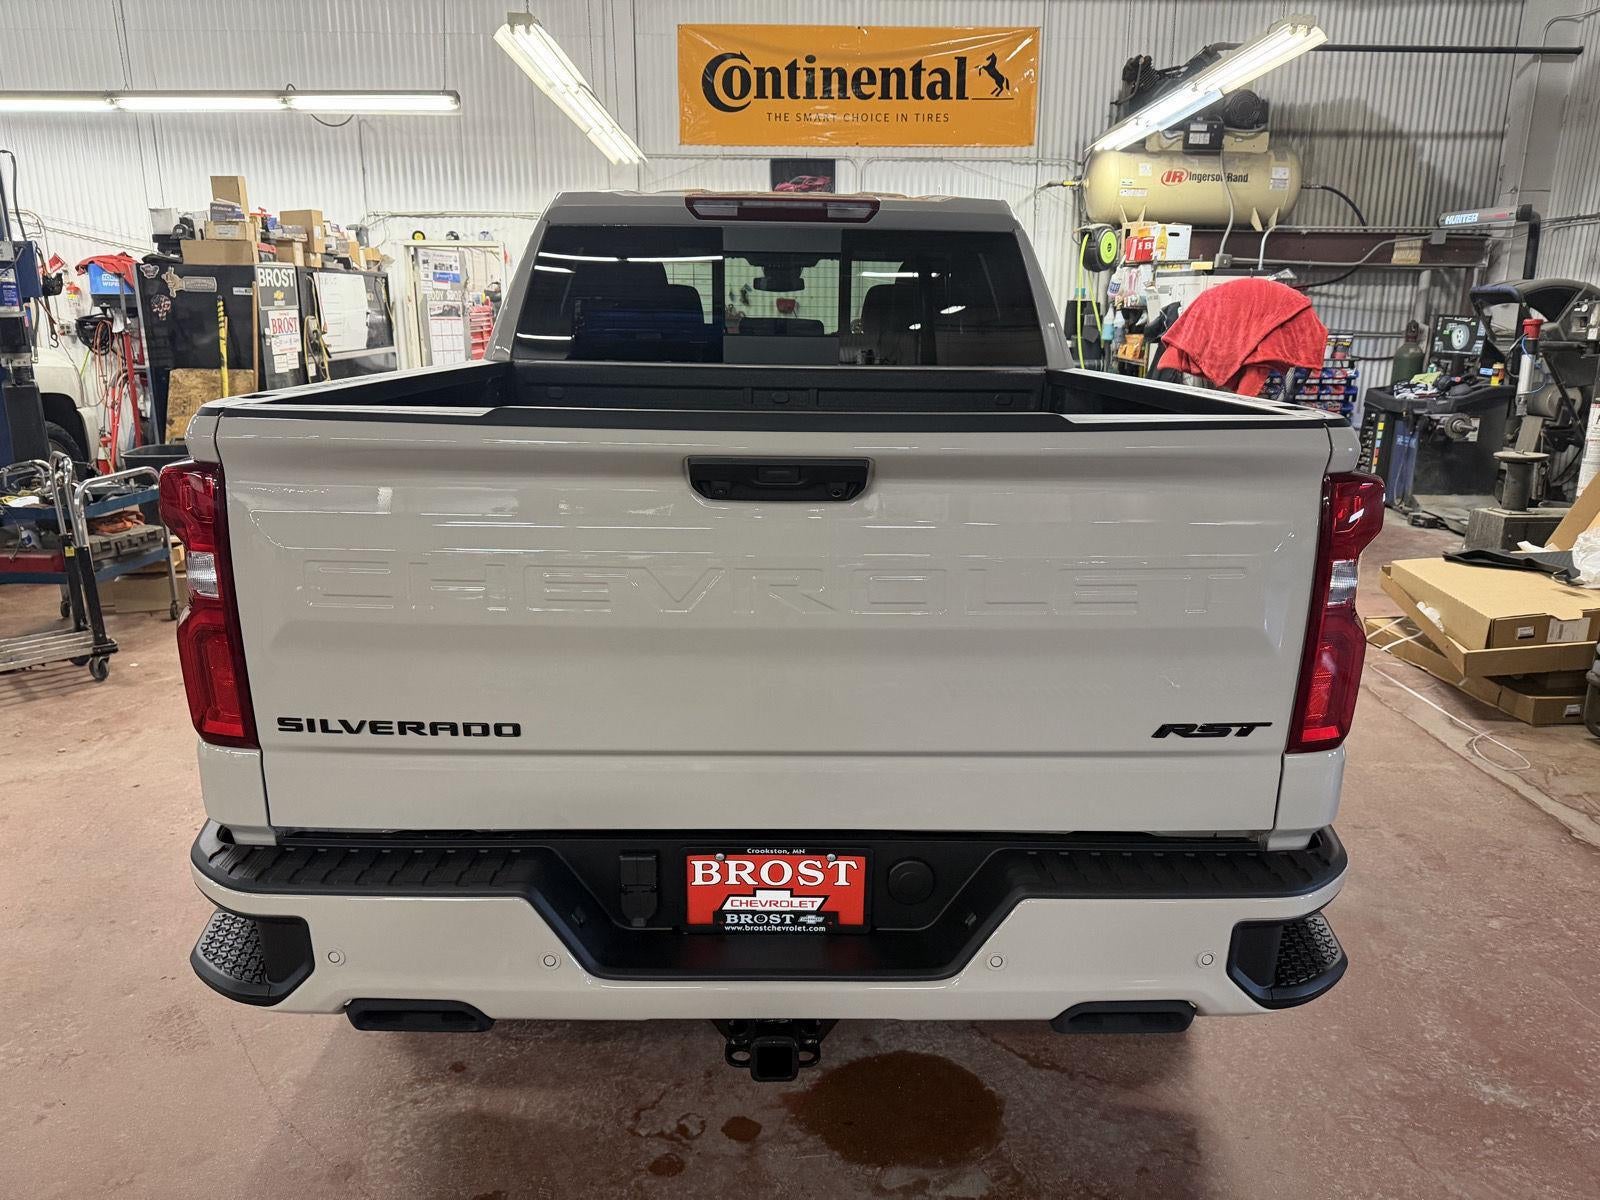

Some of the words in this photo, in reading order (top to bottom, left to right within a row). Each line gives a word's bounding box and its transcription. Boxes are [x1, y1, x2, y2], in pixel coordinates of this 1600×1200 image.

[701, 50, 969, 113] Continental
[766, 112, 790, 122] THE
[796, 112, 837, 122] SMART
[843, 112, 890, 122] CHOICE
[896, 112, 908, 122] IN
[914, 112, 950, 123] TIRES
[1444, 212, 1479, 225] HUNTER
[257, 268, 295, 288] BROST
[271, 317, 299, 335] BROST
[302, 558, 1248, 615] CHEVROLET
[277, 717, 522, 738] SILVERADO
[1151, 722, 1273, 739] RST
[690, 859, 859, 887] BROST
[730, 899, 818, 908] CHEVROLET
[724, 913, 795, 924] BROST
[724, 924, 826, 932] www.brostchevrolet.com
